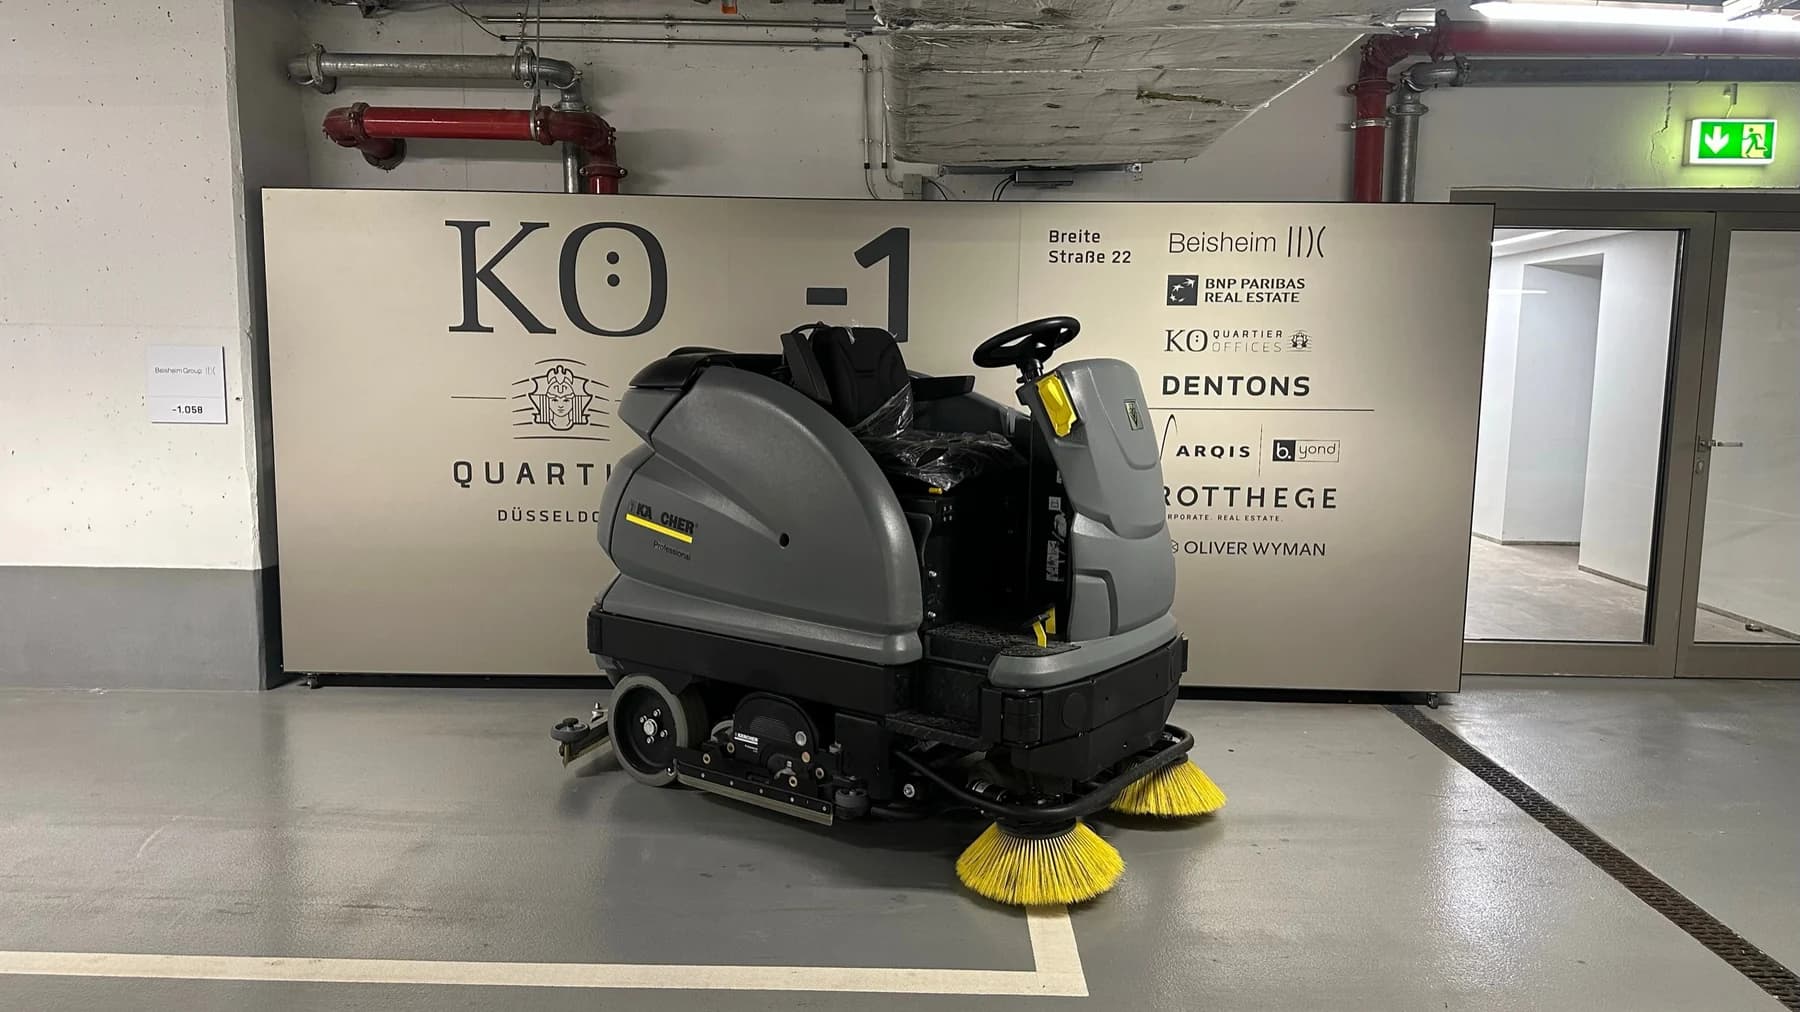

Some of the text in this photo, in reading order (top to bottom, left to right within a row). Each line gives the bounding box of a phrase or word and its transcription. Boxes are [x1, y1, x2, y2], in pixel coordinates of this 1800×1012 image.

[1048, 229, 1101, 243] Breite
[1169, 231, 1276, 254] Beisheim
[1048, 250, 1131, 264] Straße 22
[806, 227, 910, 343] -1
[1205, 278, 1305, 289] BNP PARIBAS
[1204, 292, 1300, 303] REAL ESTATE
[1212, 330, 1283, 339] QUARTIER
[1211, 342, 1282, 352] OFFICES
[1162, 375, 1310, 397] DENTONS
[172, 405, 203, 414] -1.058
[1176, 445, 1250, 459] ARQIS
[453, 461, 612, 488] QUARTI
[1244, 514, 1284, 522] ESTATE.
[1184, 541, 1326, 556] OLIVER WYMAN
